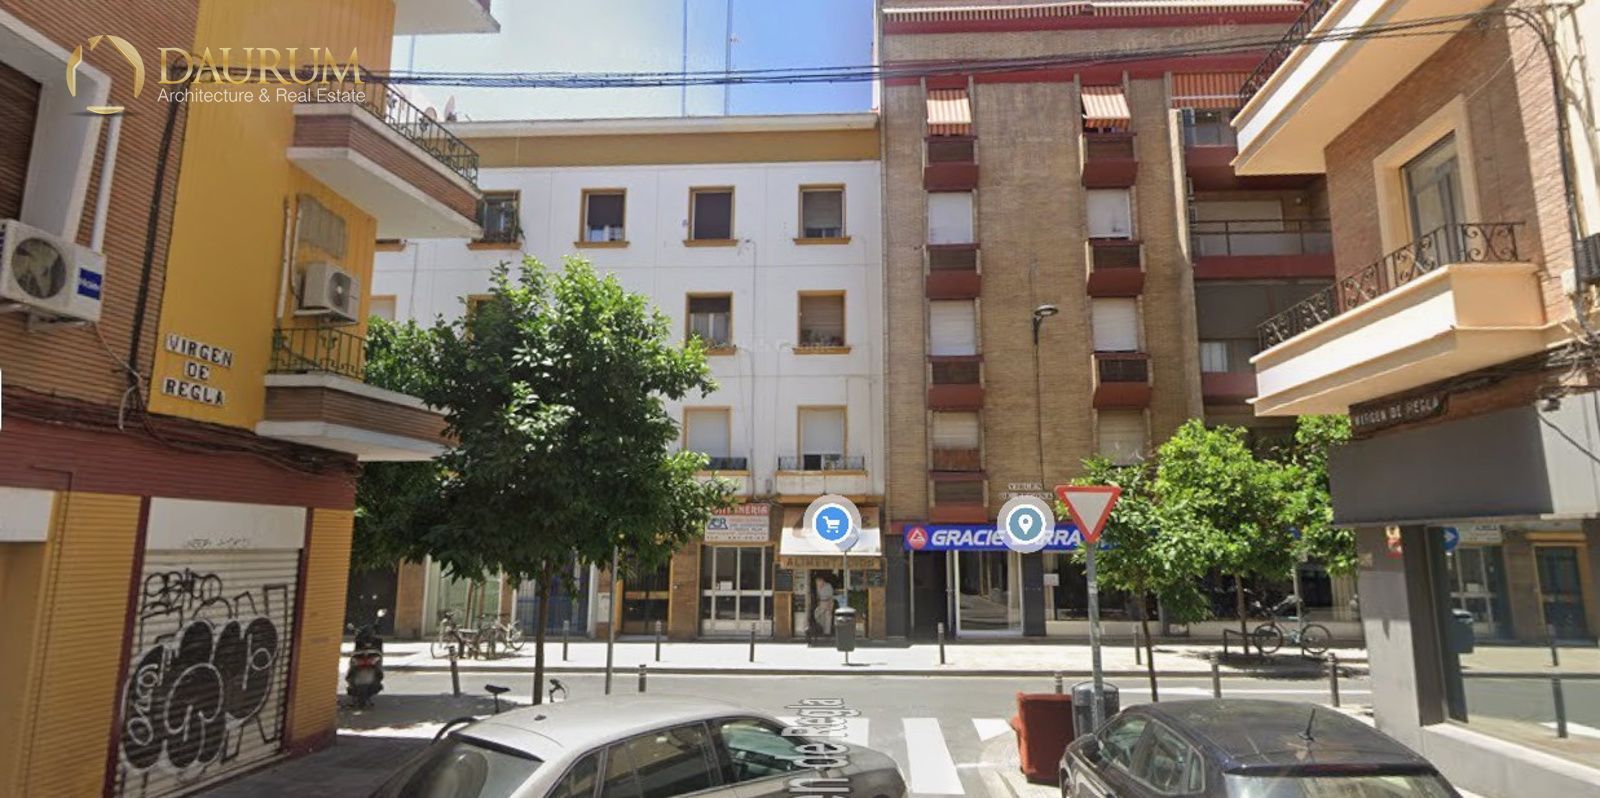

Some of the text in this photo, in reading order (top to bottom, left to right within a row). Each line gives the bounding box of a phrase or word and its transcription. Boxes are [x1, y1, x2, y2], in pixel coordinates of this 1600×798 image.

[169, 335, 233, 366] VIRGEN
[187, 361, 209, 380] DE
[165, 378, 224, 405] REGLA
[931, 529, 1005, 547] GRACIE
